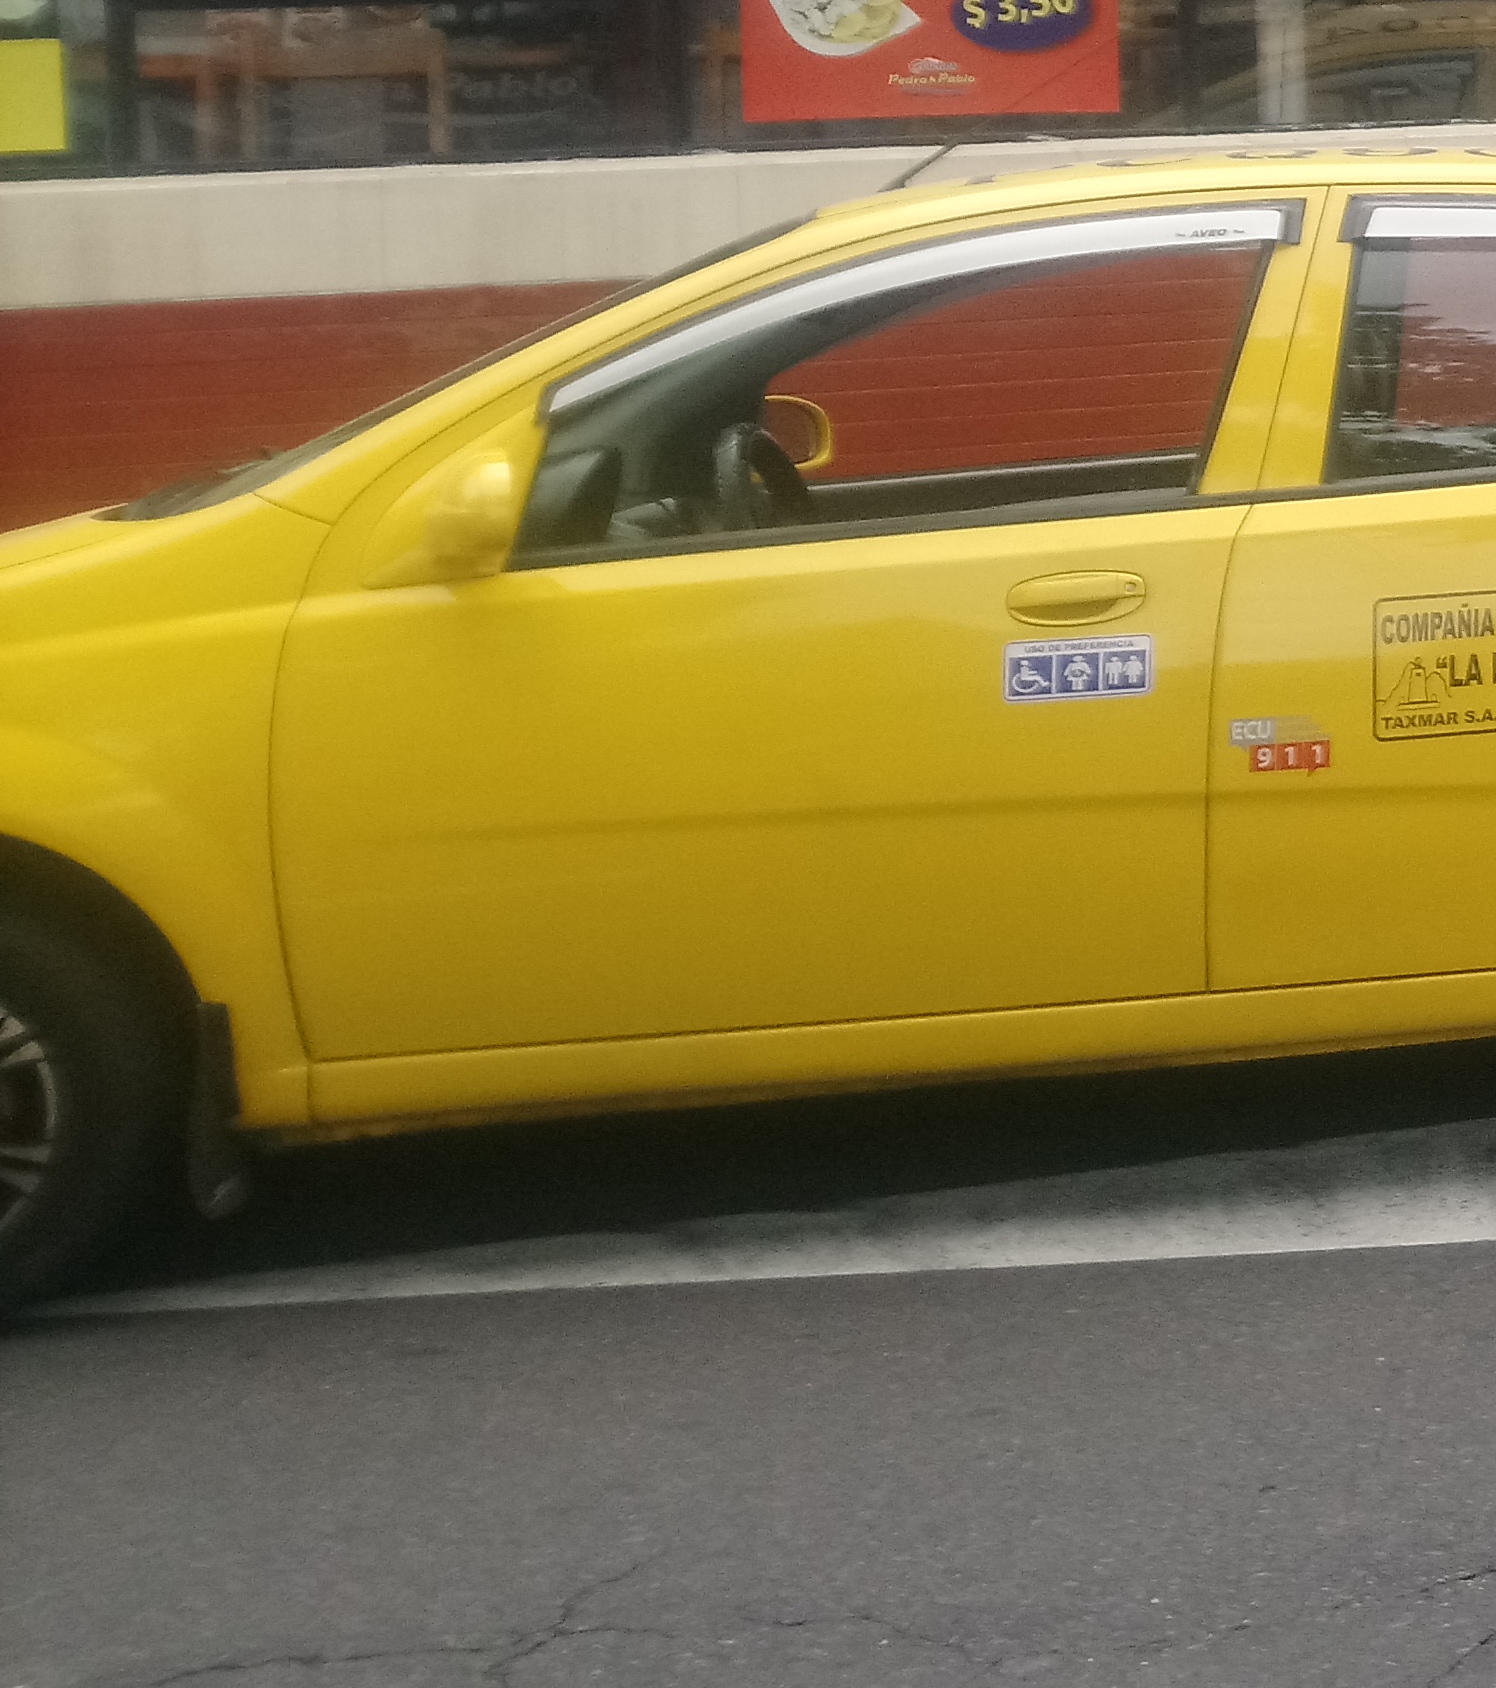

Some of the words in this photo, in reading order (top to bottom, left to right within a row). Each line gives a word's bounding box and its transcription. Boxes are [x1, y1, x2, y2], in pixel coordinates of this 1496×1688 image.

[1189, 228, 1228, 238] AVEO
[1380, 603, 1495, 645] COMPAÑIA
[1024, 644, 1045, 654] USO
[1048, 643, 1061, 652] DE
[1064, 639, 1134, 652] PREFERENCIA
[1380, 711, 1459, 730] TAXMAR
[1231, 720, 1272, 741] ECU
